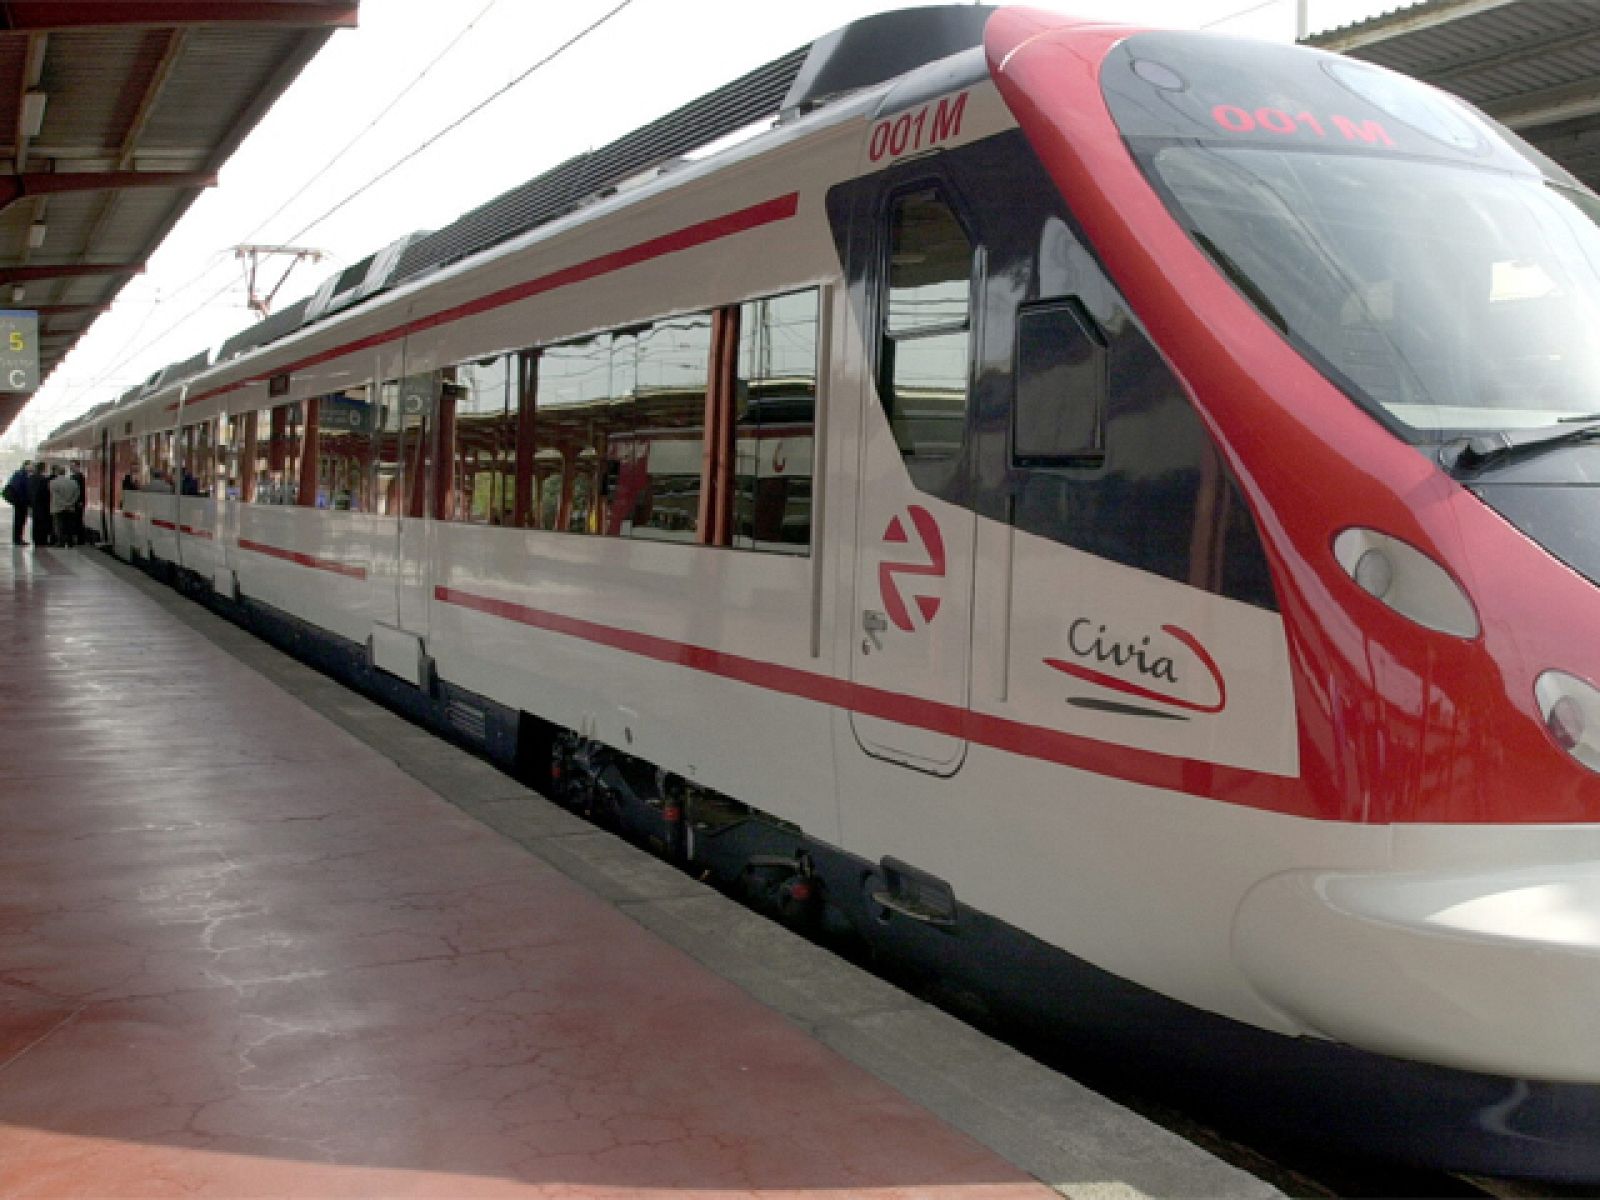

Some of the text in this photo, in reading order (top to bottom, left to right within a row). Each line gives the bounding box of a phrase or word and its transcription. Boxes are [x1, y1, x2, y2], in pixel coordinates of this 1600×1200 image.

[869, 91, 969, 162] 001 M
[1211, 104, 1395, 146] 001 M
[9, 331, 24, 351] 5
[9, 369, 26, 389] C
[1067, 617, 1178, 683] Civia
